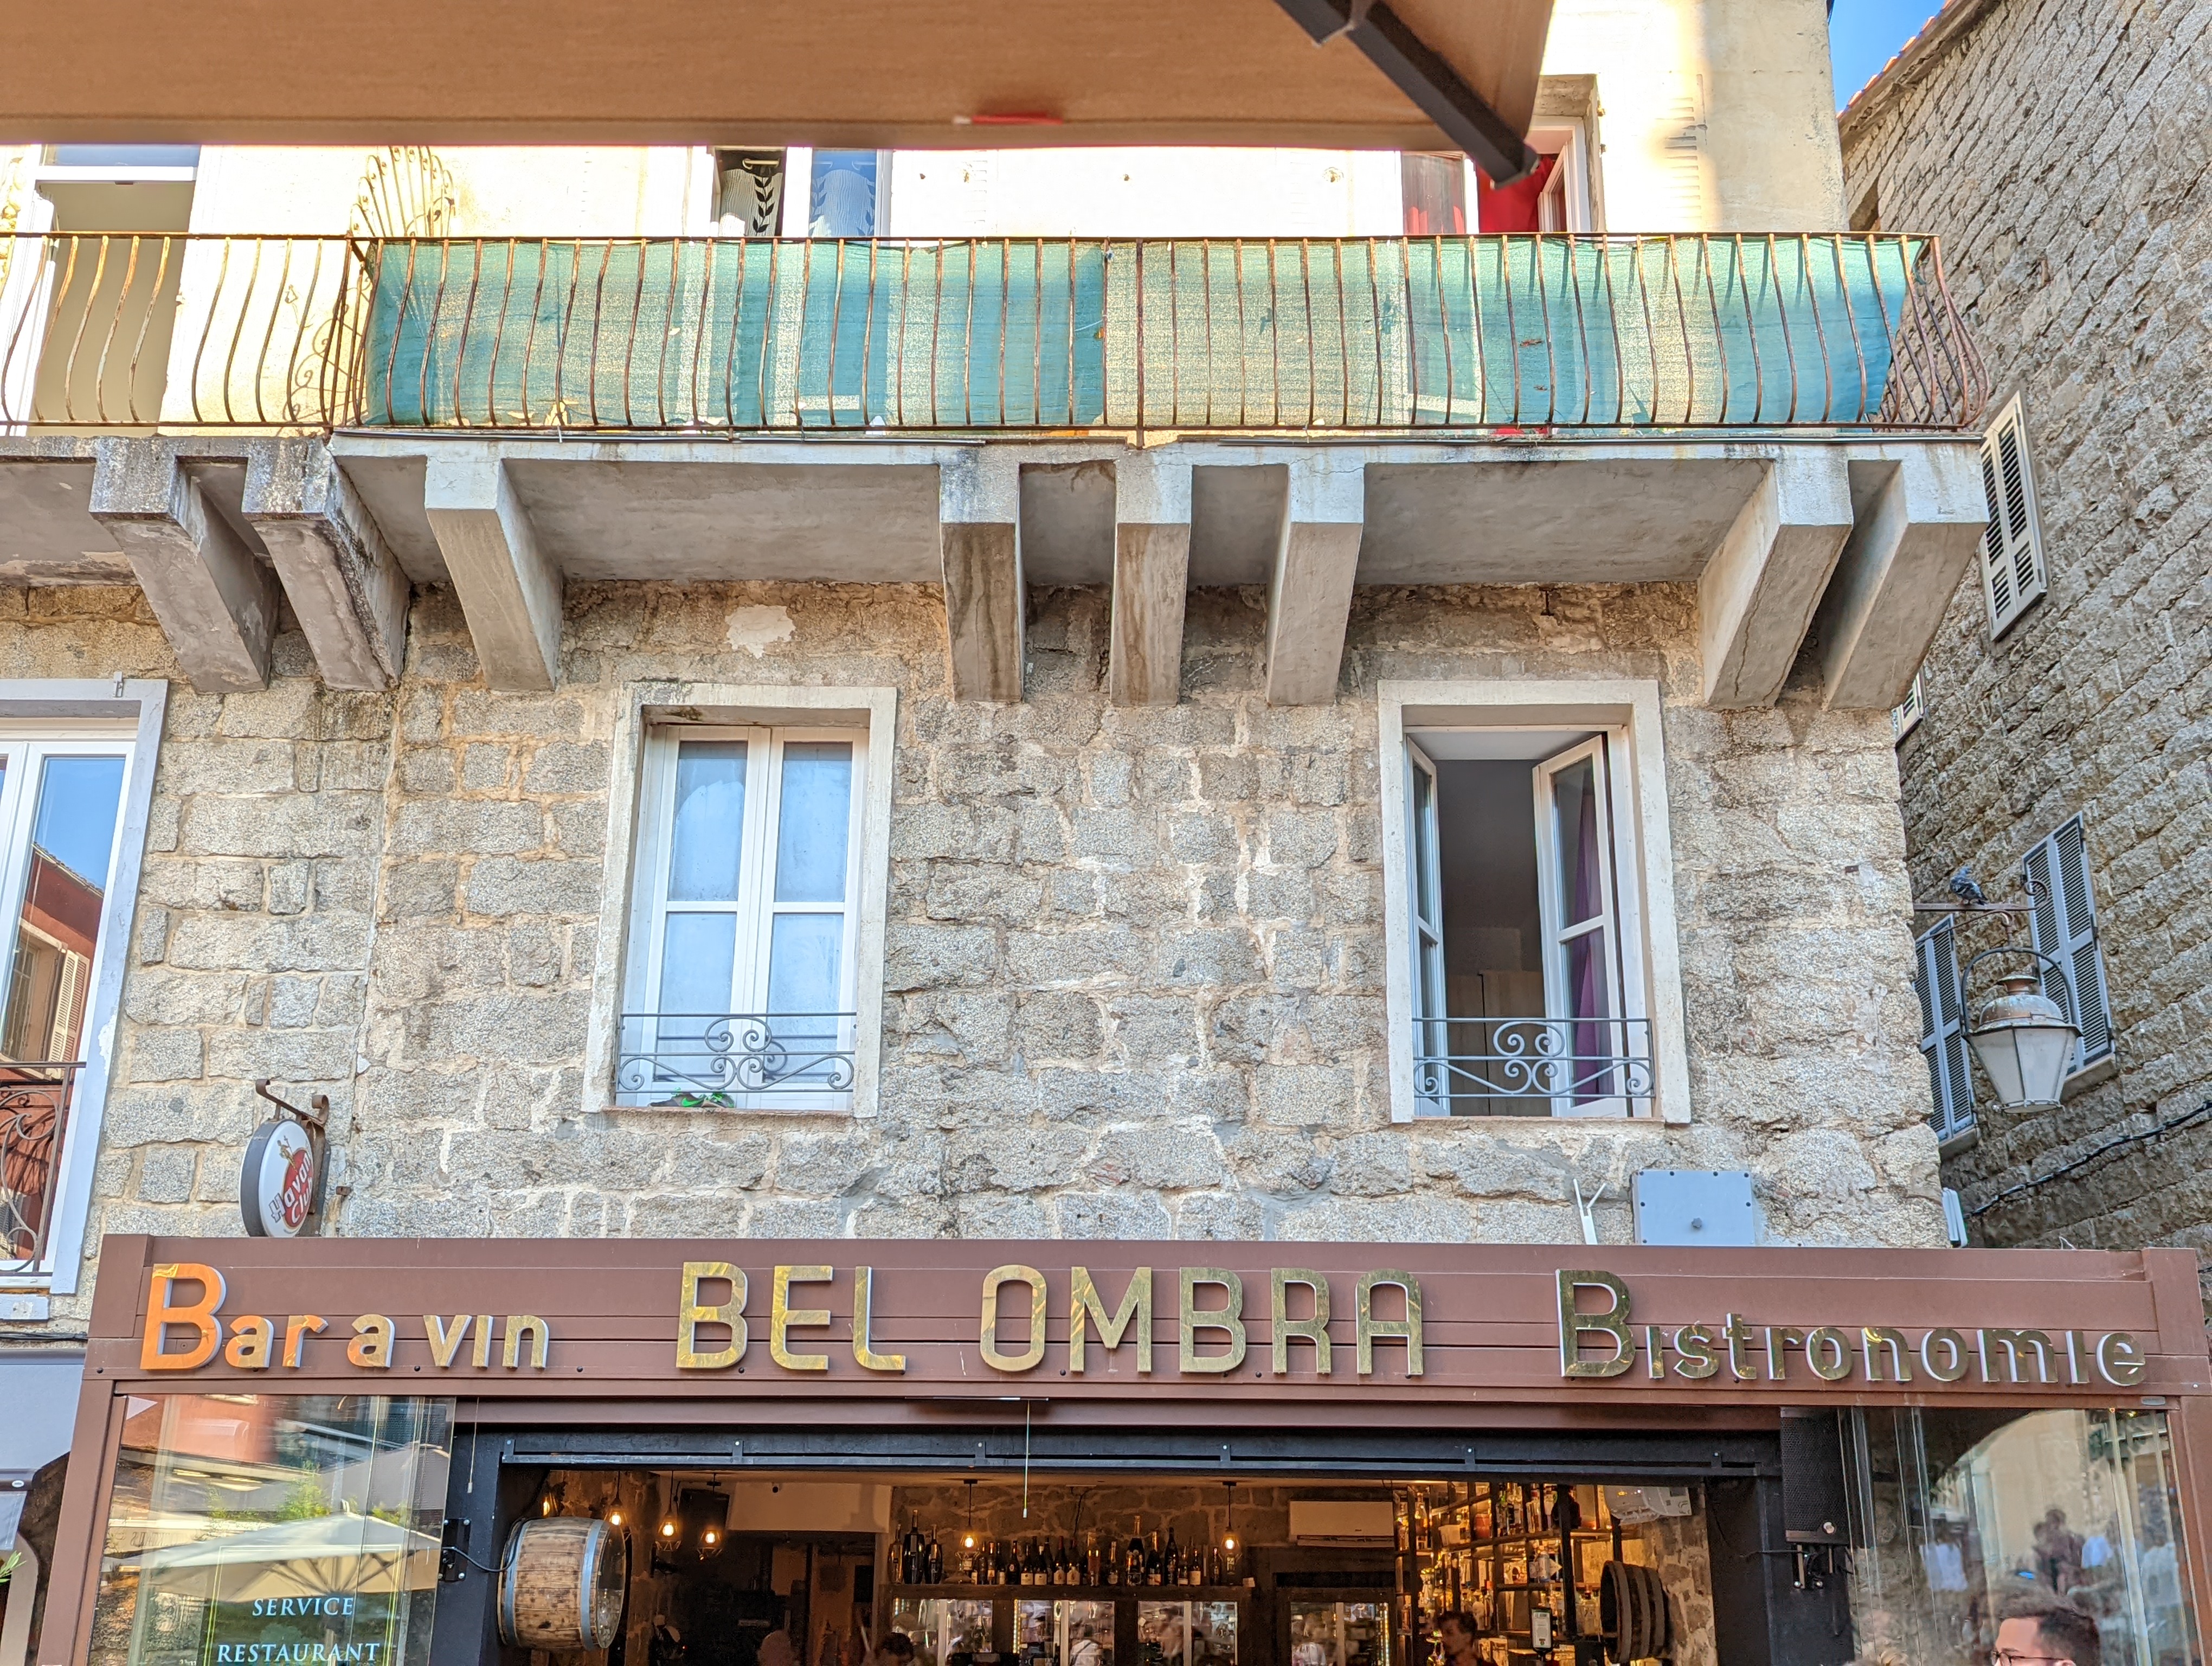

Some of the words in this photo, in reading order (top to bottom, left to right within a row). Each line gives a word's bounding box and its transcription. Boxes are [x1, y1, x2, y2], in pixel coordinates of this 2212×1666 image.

[269, 1148, 311, 1223] Havan
[291, 1177, 313, 1223] Club
[140, 1263, 329, 1370] Bar
[348, 1314, 395, 1368] a
[423, 1315, 549, 1369] vin
[676, 1262, 906, 1372] BEL
[980, 1264, 1424, 1375] OMBRA
[1555, 1268, 2146, 1386] Bistronomie
[252, 1598, 354, 1617] SERVICE
[217, 1643, 380, 1663] RESTAURANT
